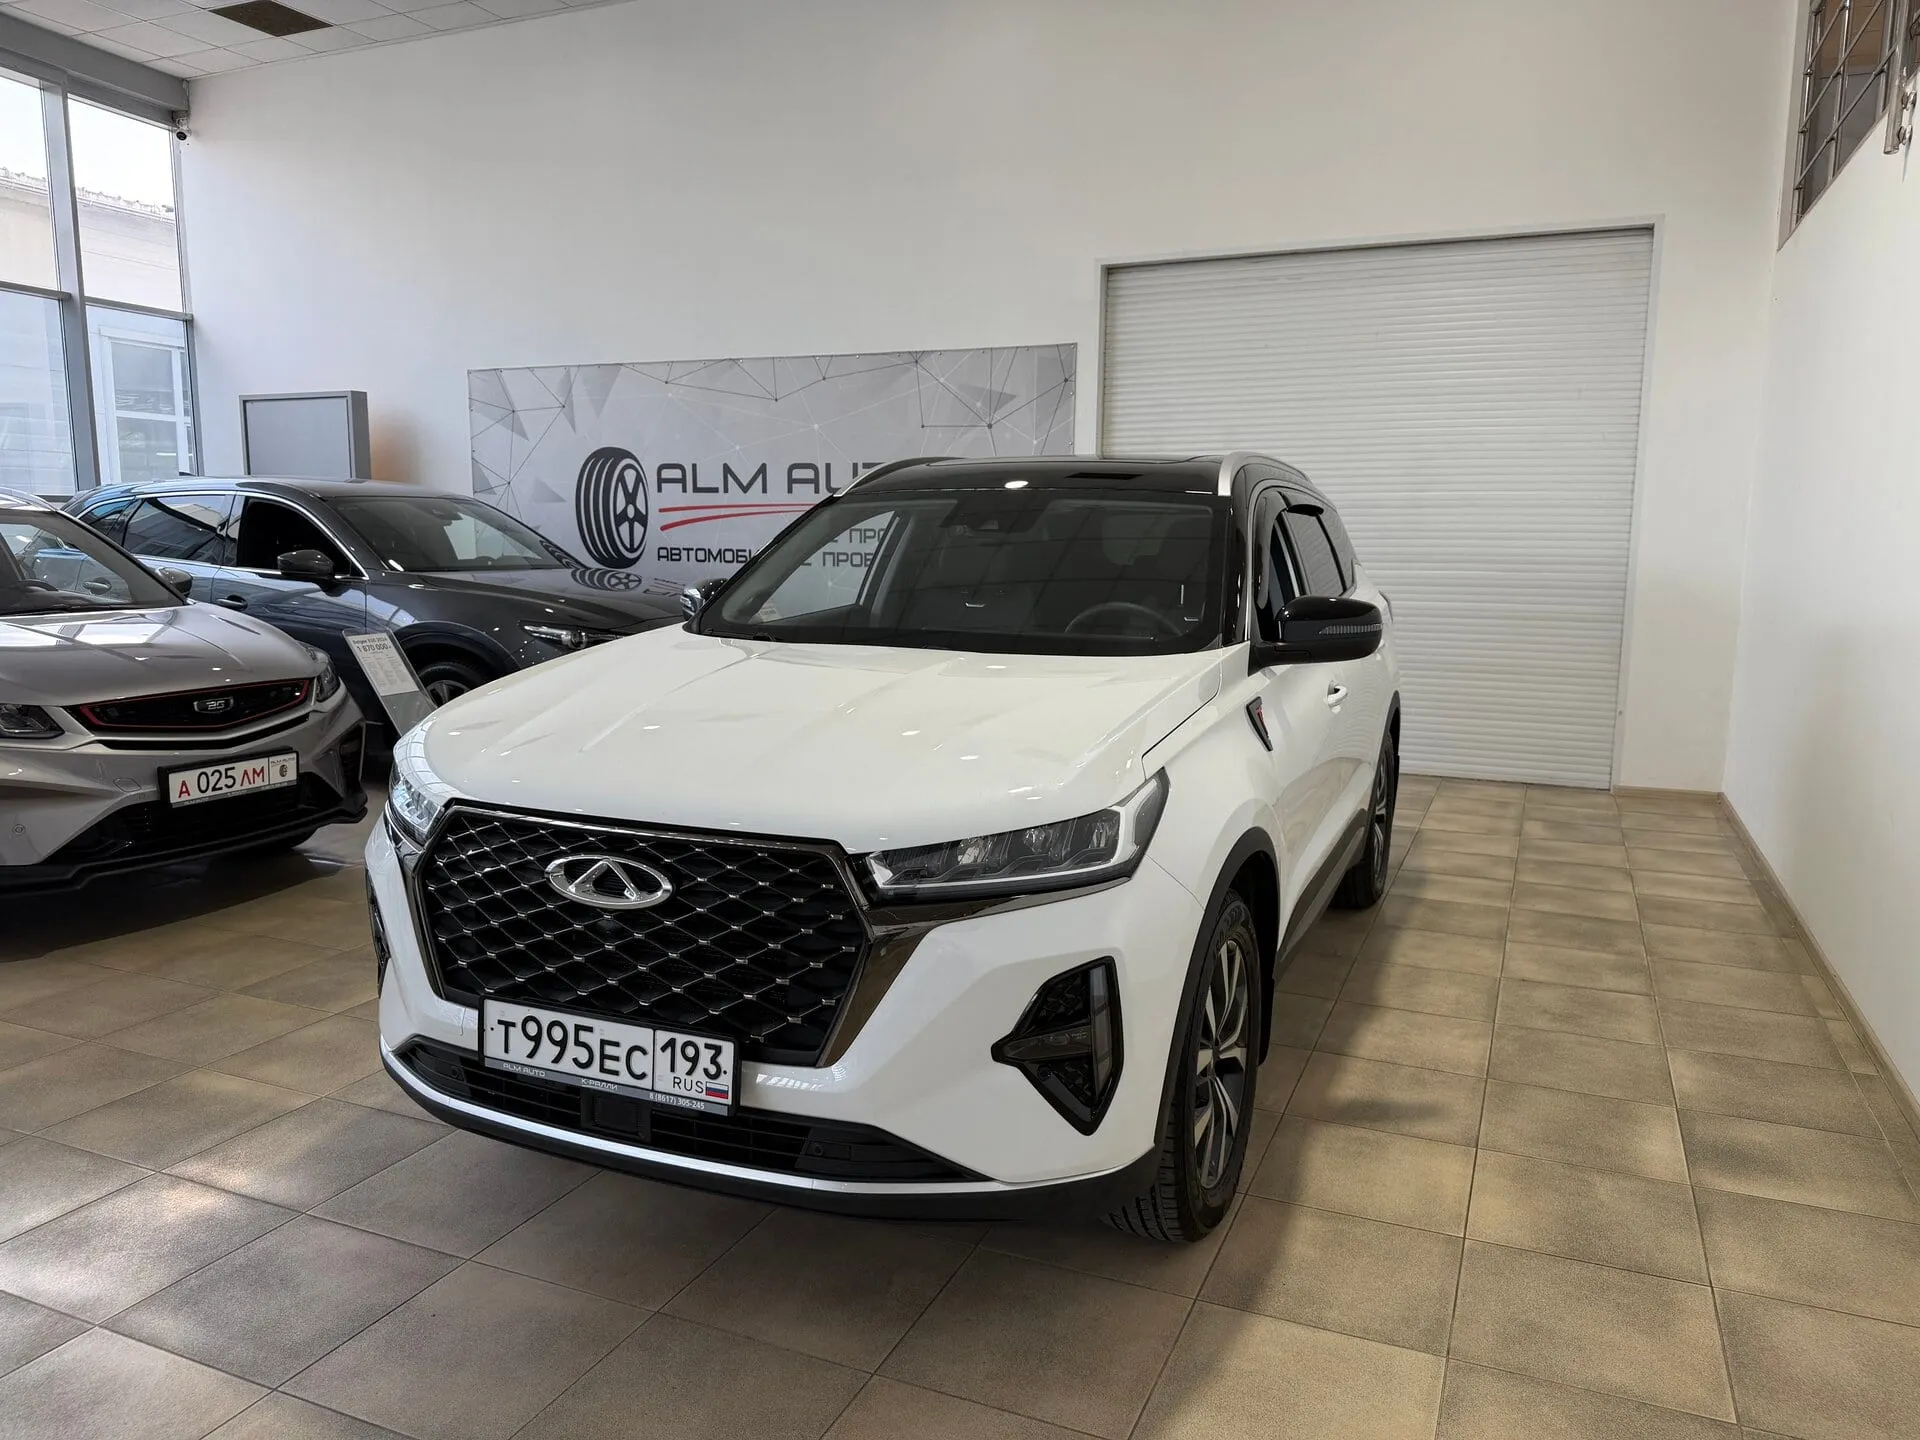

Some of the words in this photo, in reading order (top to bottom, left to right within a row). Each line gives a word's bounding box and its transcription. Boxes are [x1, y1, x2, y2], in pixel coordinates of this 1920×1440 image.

[656, 462, 767, 494] ALM
[197, 767, 237, 794] 025
[502, 1062, 522, 1072] ALM
[522, 1067, 546, 1077] AUTO
[660, 1038, 723, 1080] 193
[673, 1076, 704, 1094] RUS
